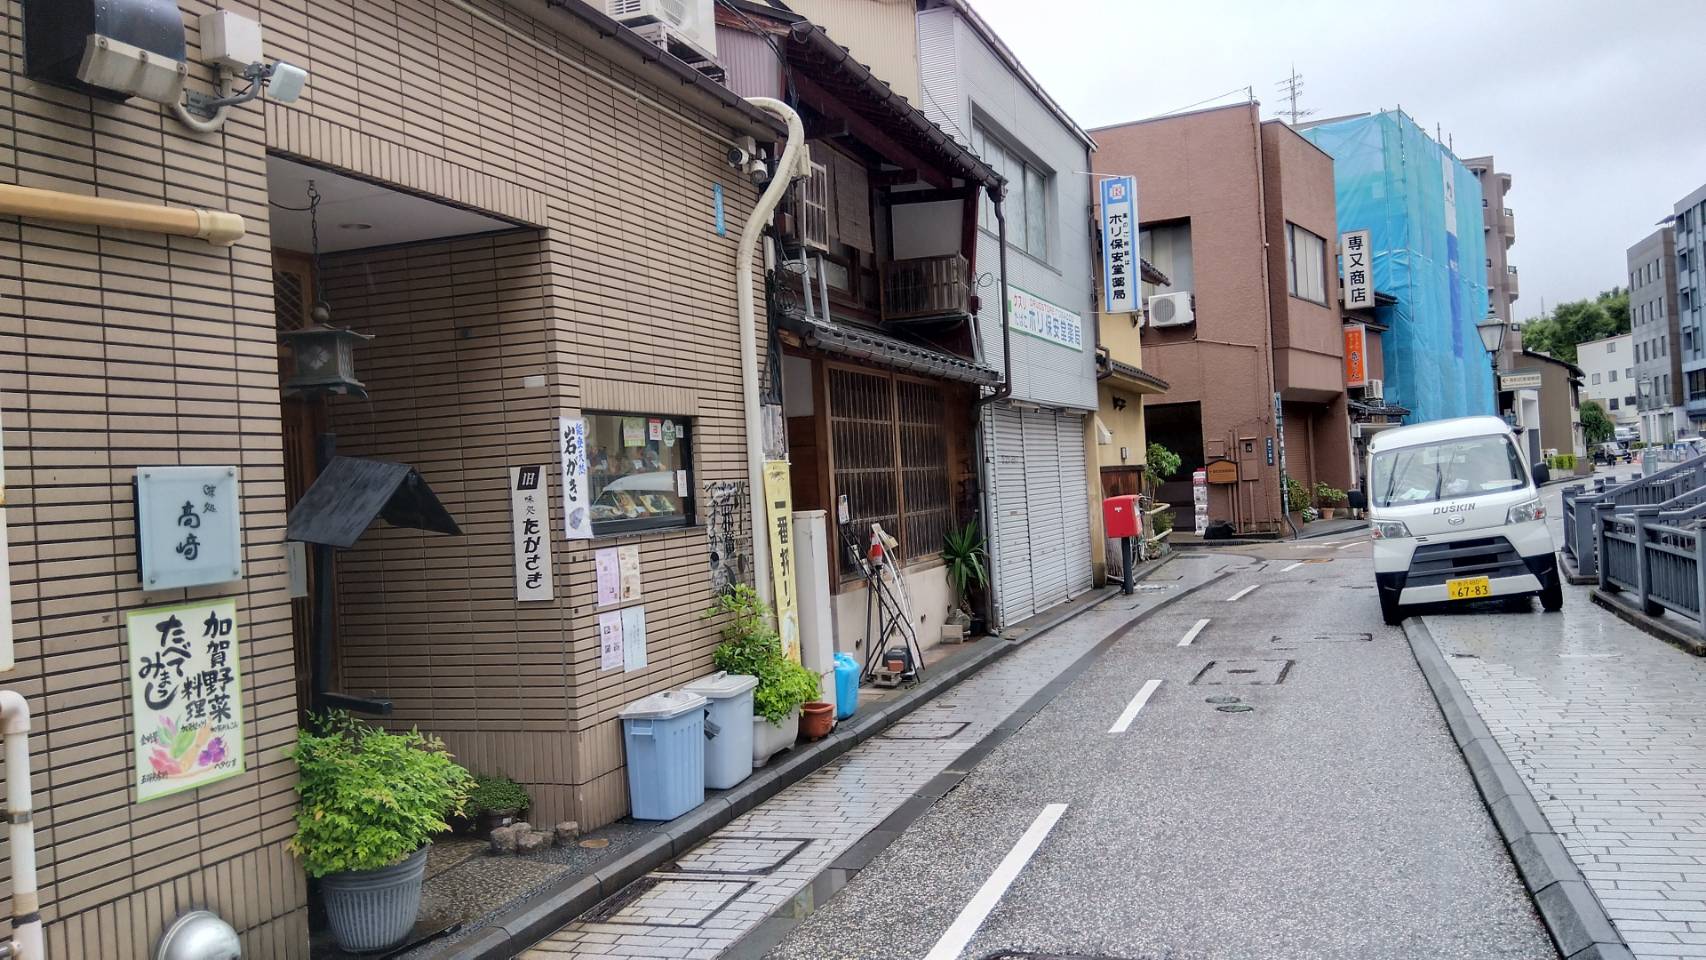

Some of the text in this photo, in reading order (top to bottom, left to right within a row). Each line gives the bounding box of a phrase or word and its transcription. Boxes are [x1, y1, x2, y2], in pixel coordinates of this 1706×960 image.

[1109, 214, 1126, 300] ホリ保安堂薬局
[1348, 235, 1366, 303] 専又商店
[1028, 309, 1080, 345] ホリ保安堂薬局
[563, 425, 578, 502] 岩がき
[1433, 502, 1476, 515] DUSKIN
[1457, 584, 1488, 598] 67-83
[202, 610, 234, 723] 加賀野菜
[181, 673, 206, 721] 料理
